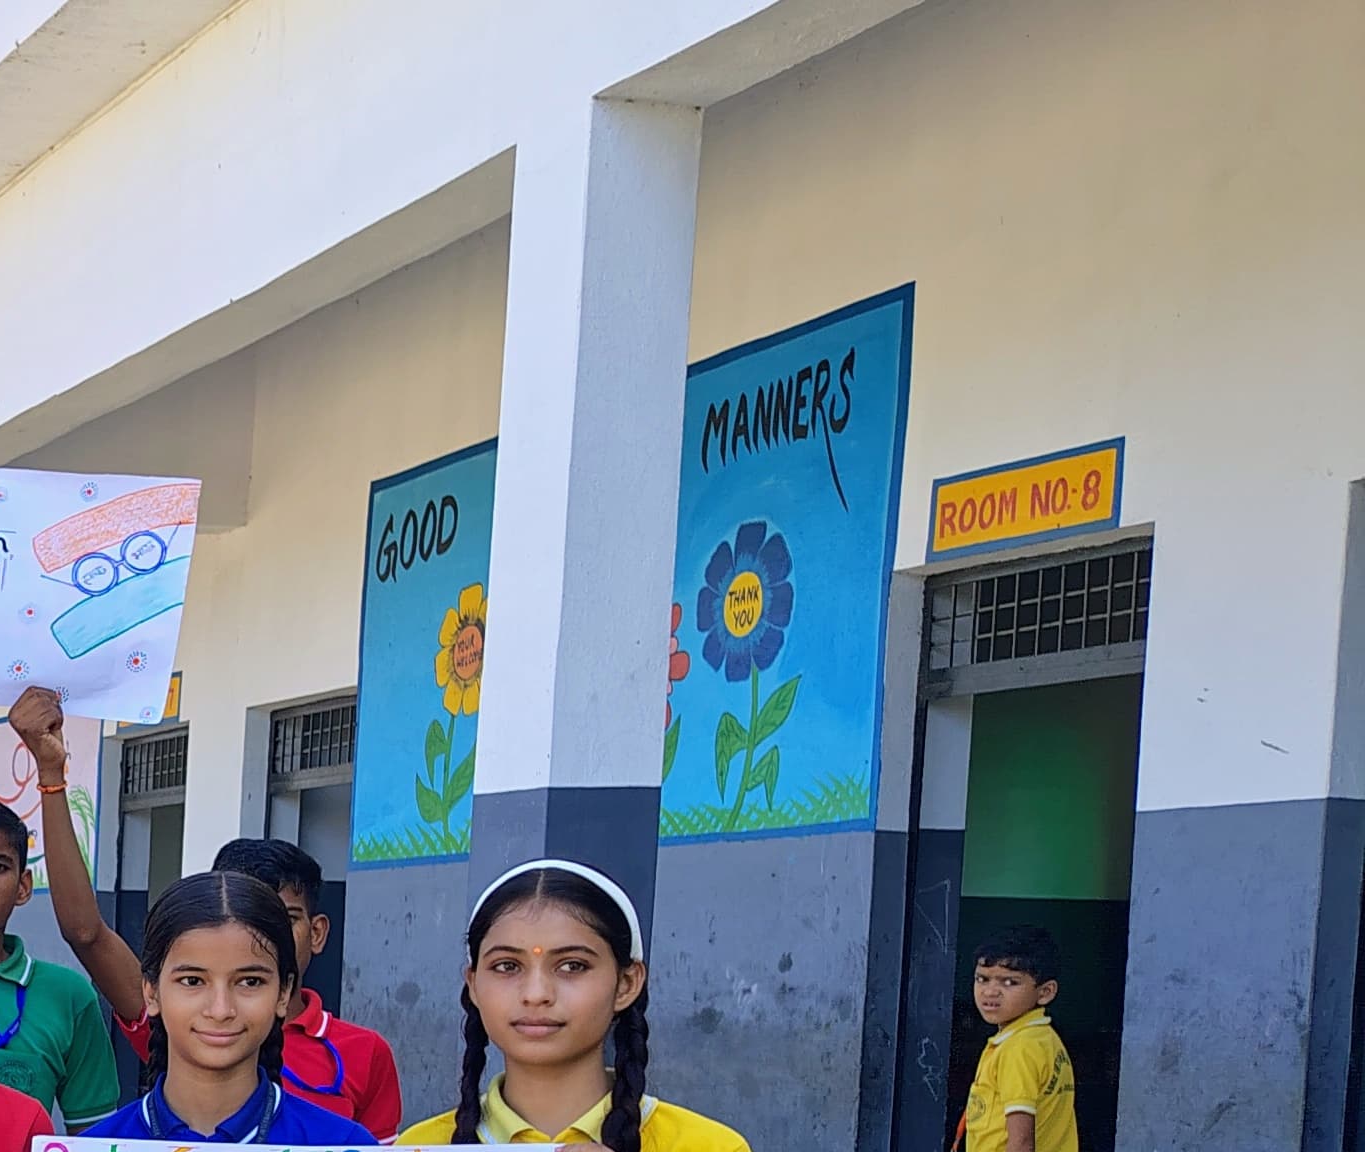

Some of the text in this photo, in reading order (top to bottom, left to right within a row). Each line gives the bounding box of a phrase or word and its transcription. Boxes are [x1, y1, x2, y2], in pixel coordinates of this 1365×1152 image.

[701, 347, 856, 512] MANNERS
[375, 495, 459, 583] GOOD
[939, 487, 1018, 539] ROOM
[729, 584, 760, 609] THANK
[733, 606, 755, 630] YOU
